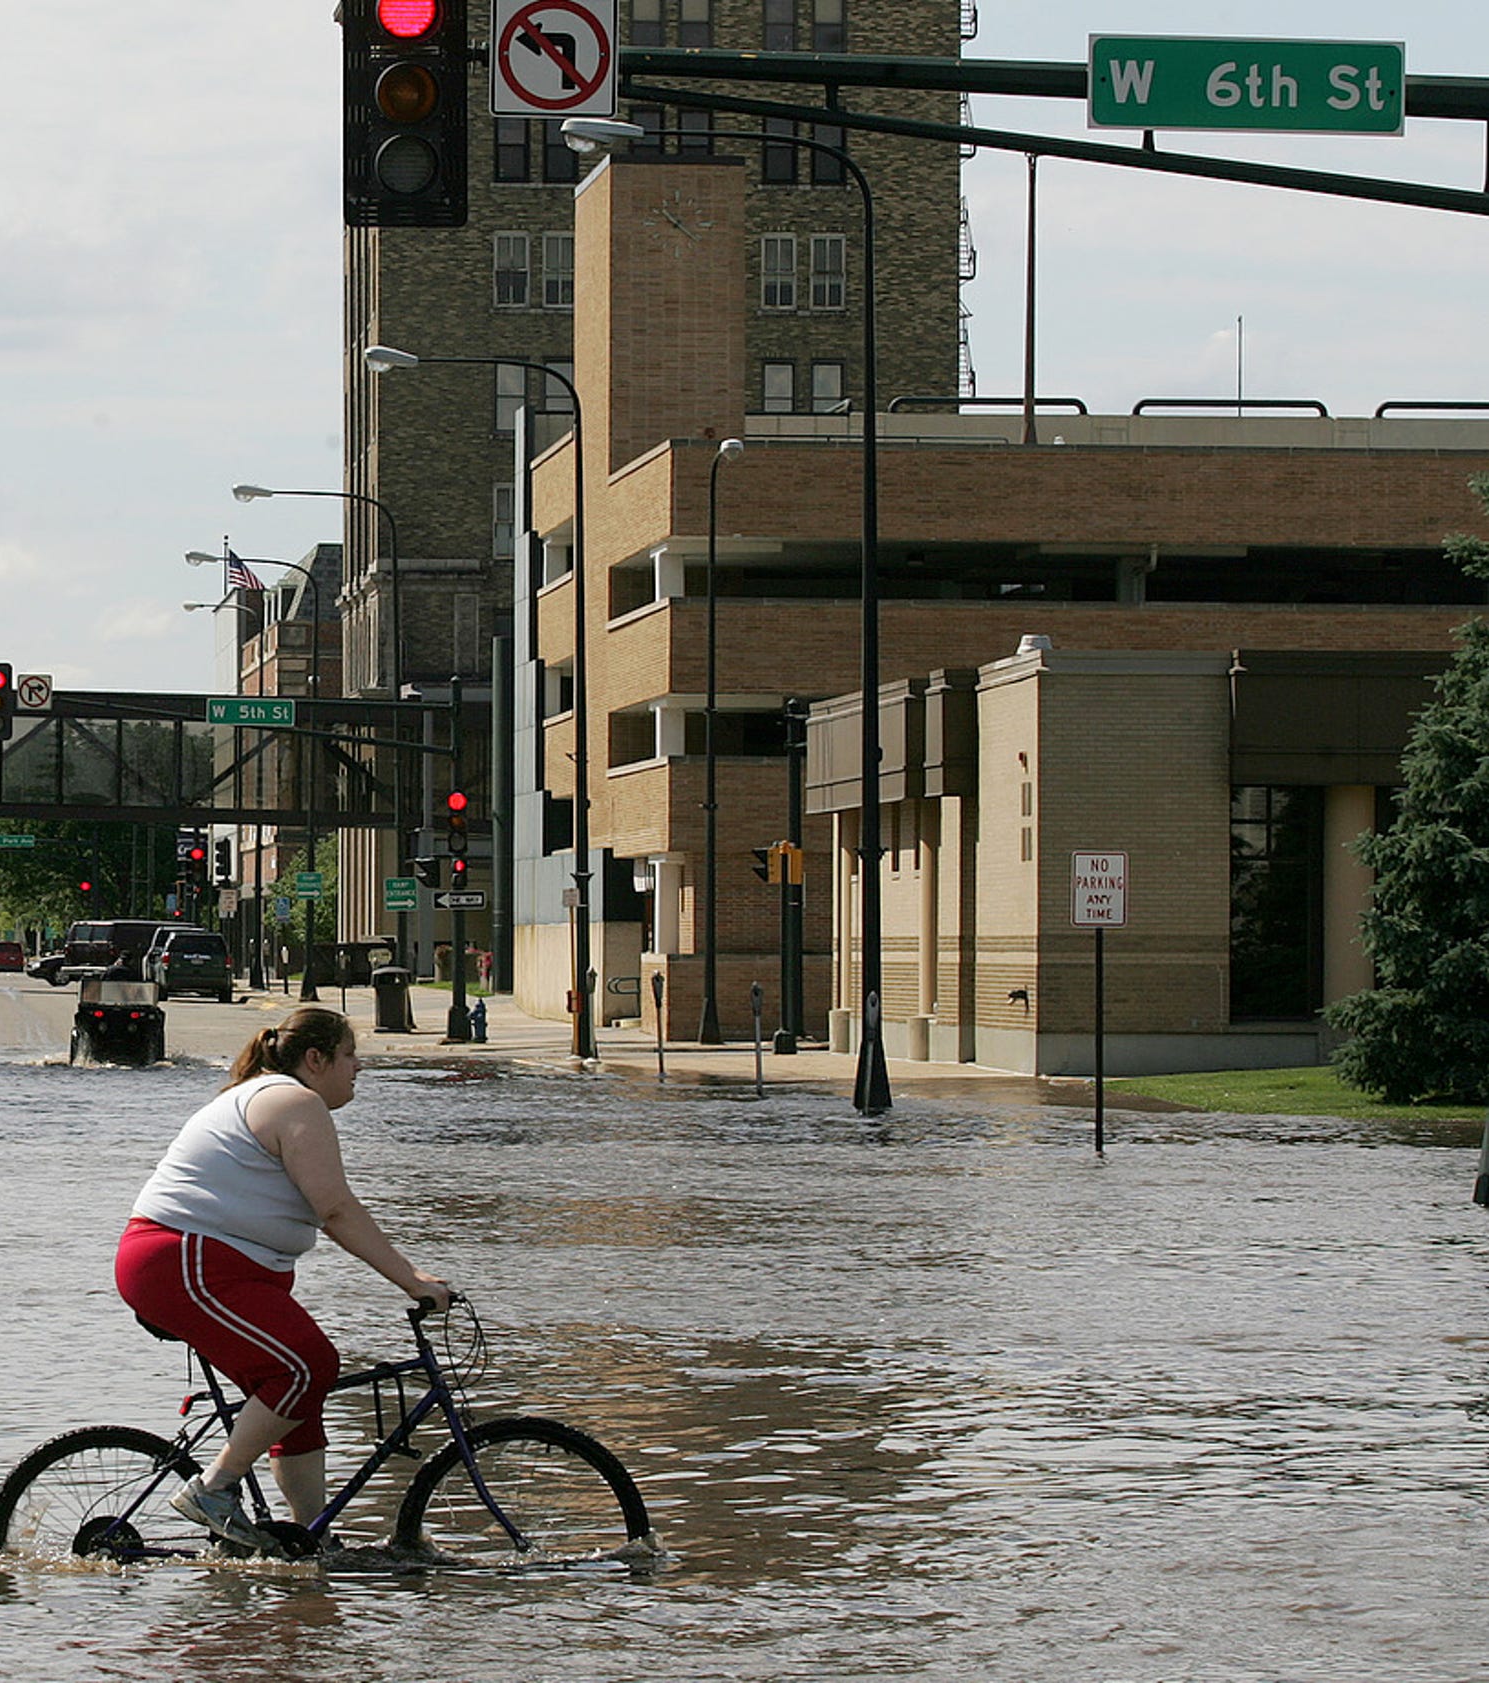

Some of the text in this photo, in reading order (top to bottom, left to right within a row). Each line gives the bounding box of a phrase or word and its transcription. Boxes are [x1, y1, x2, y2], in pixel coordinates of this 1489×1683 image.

[1109, 59, 1386, 111] W 6th St
[212, 704, 289, 720] W 5th St
[1090, 858, 1110, 873] NO
[1076, 876, 1124, 890] PARKING
[1086, 894, 1114, 905] ANY
[1086, 908, 1114, 920] TIME
